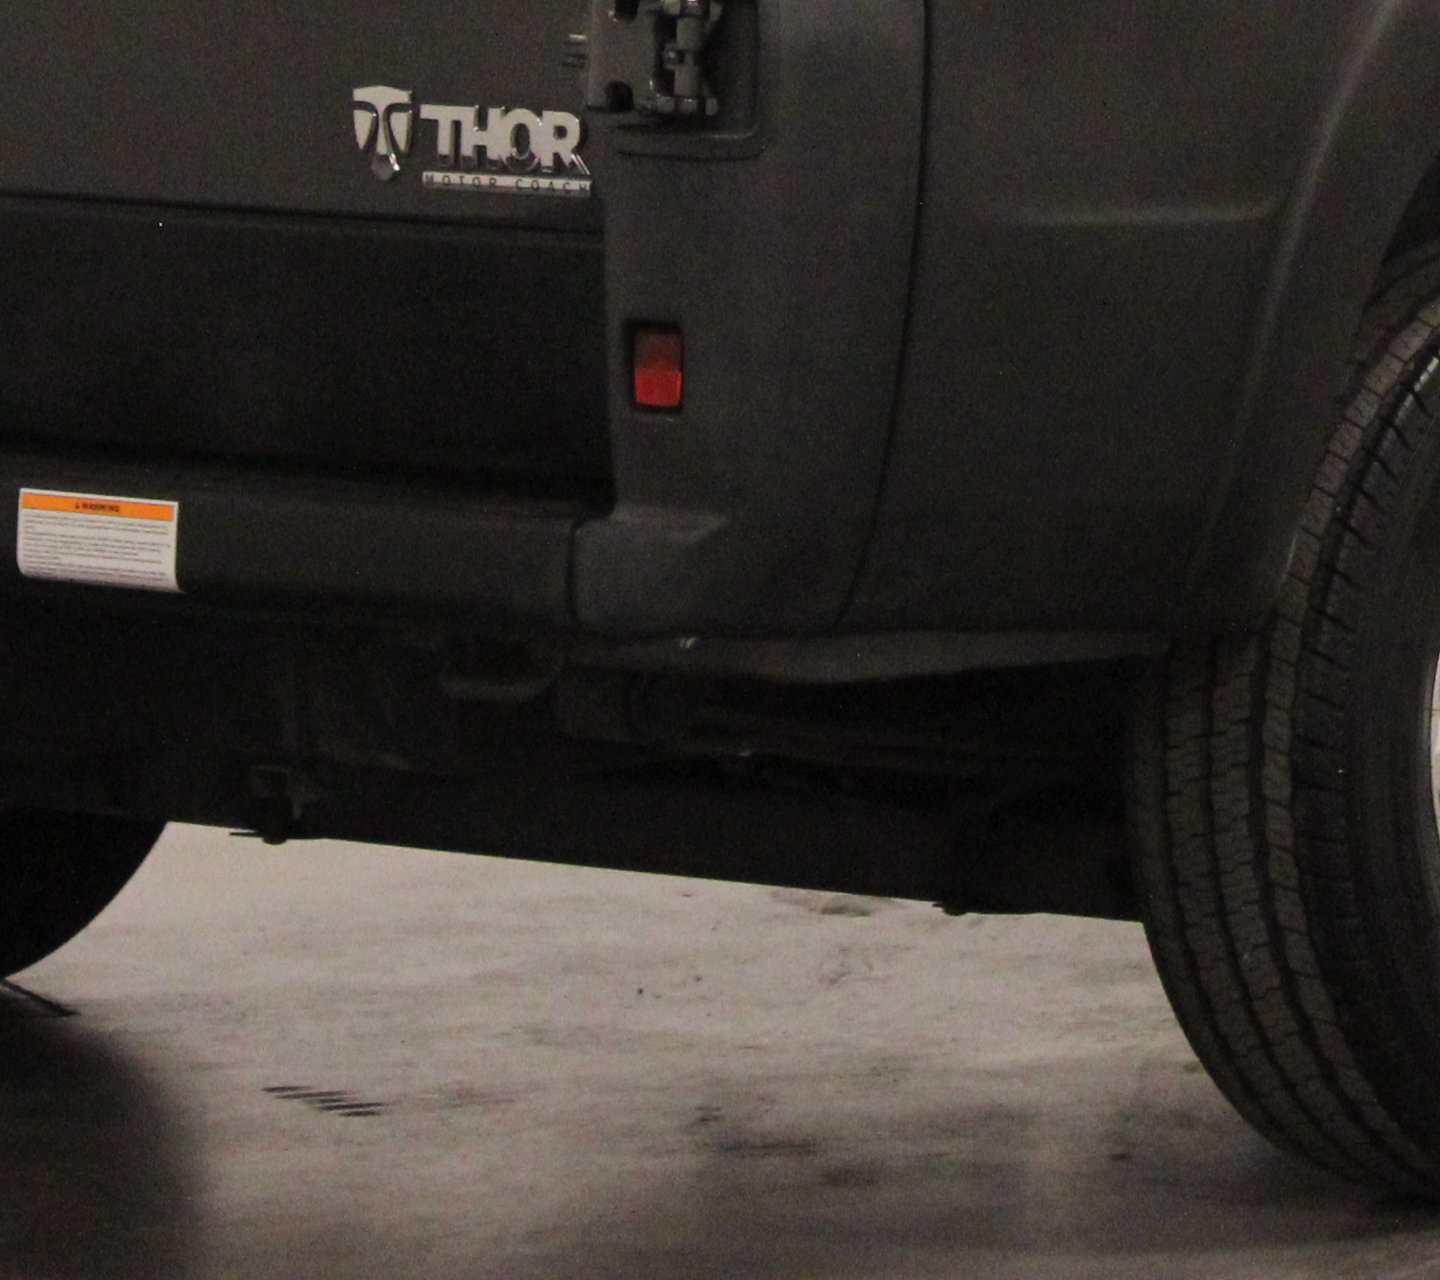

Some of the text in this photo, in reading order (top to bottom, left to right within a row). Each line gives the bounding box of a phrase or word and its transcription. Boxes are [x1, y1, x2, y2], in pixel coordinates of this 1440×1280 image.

[420, 103, 590, 177] THOR
[425, 173, 590, 194] MOTOR COACH
